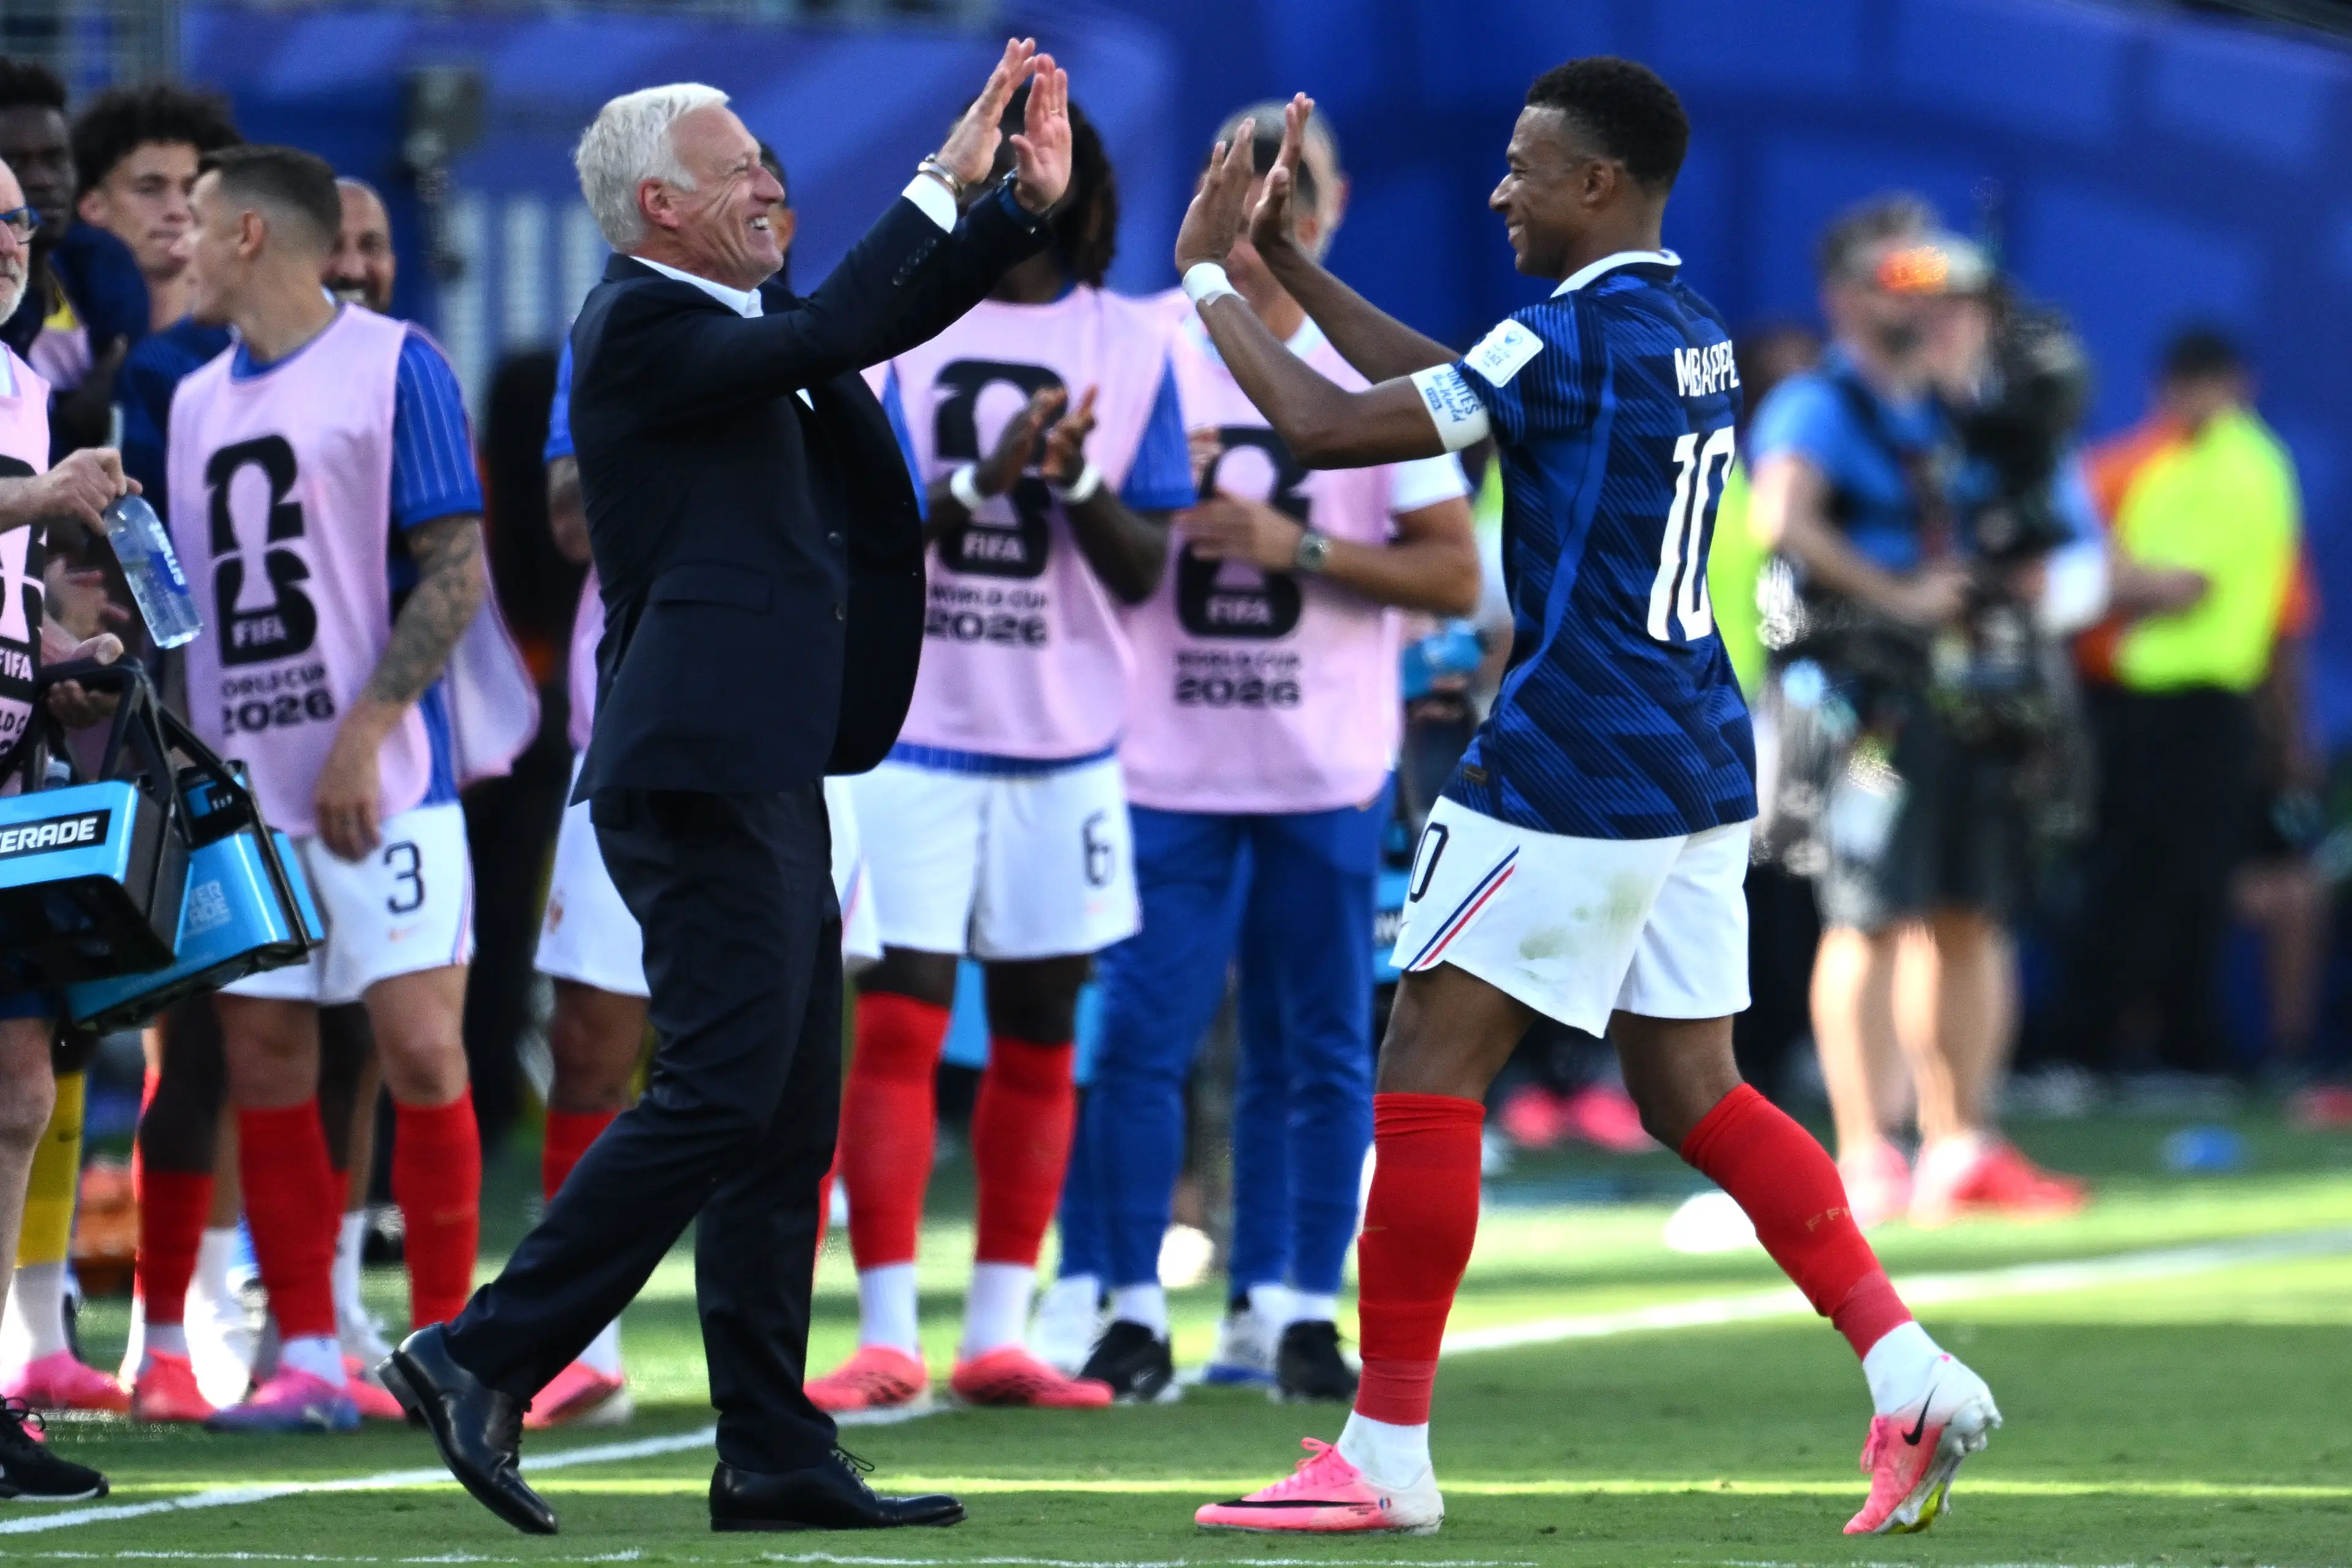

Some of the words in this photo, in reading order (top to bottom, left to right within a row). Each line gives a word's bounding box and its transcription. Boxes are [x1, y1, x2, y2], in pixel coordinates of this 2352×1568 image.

[1647, 426, 1735, 641] 10
[925, 609, 1047, 648] 2026
[1175, 676, 1302, 710] 2026
[0, 817, 98, 853] ERADE
[1081, 809, 1116, 890] 6
[1409, 821, 1450, 903] 0
[382, 839, 425, 914] 3
